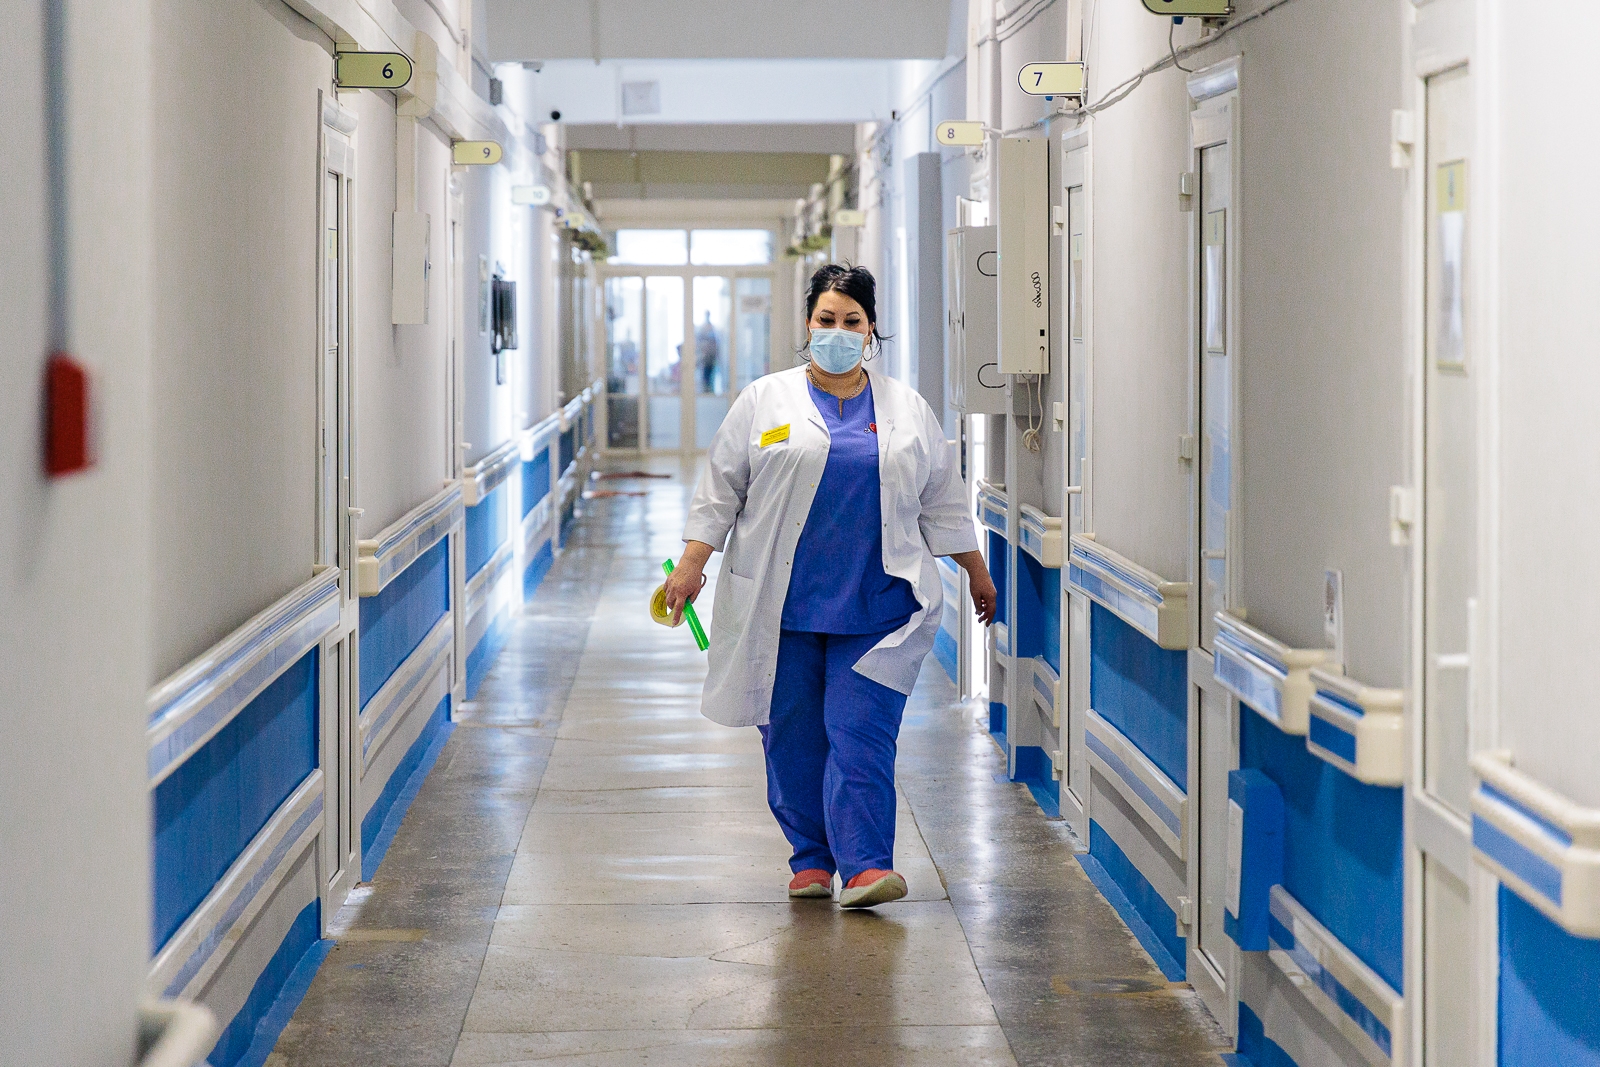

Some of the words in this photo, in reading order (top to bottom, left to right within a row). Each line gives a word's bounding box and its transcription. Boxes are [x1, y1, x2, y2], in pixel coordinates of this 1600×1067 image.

[382, 62, 394, 79] 6
[1033, 72, 1043, 86] 7
[947, 128, 955, 139] 8
[482, 147, 491, 159] 9
